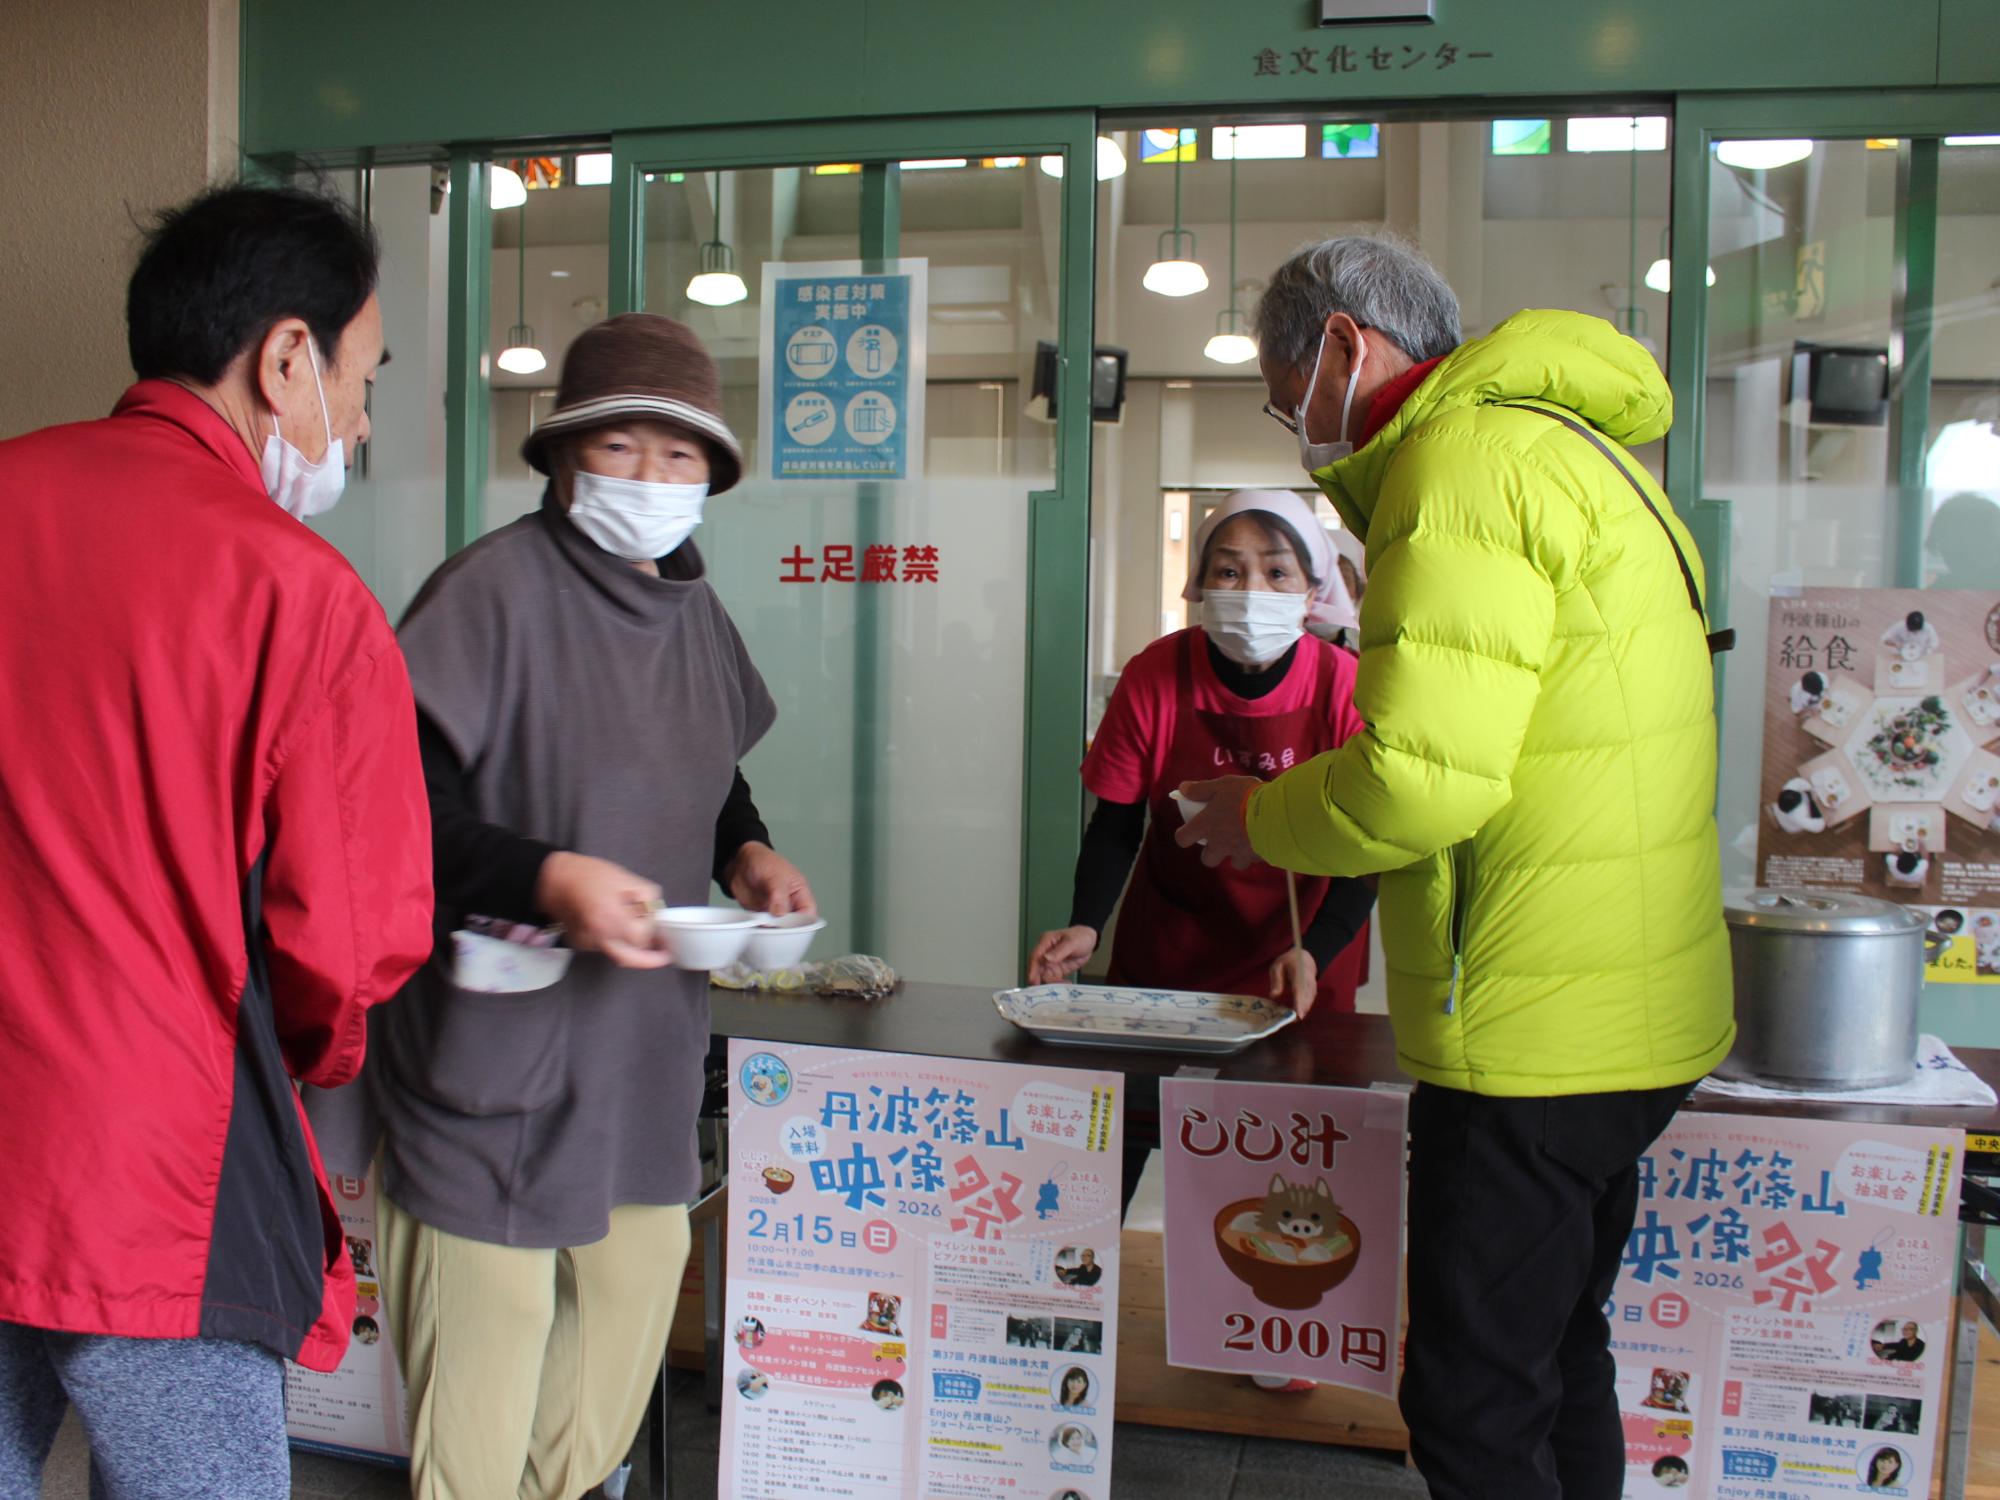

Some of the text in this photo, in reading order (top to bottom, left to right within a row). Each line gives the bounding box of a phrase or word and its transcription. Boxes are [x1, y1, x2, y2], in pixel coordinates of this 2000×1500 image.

[1253, 42, 1494, 77] 食文化センター
[797, 283, 886, 302] 感染症対策
[815, 303, 867, 320] 実施中
[779, 544, 939, 583] 土足厳禁
[1781, 611, 1861, 629] 丹波篠山の
[1780, 634, 1858, 671] 給食
[819, 1084, 1024, 1150] 丹波篠山
[1026, 1103, 1084, 1122] お楽しみ
[789, 1125, 816, 1139] 入場
[1030, 1119, 1077, 1138] 抽選会
[1180, 1106, 1350, 1170] しし汁
[789, 1141, 818, 1155] 無料
[1850, 1164, 1918, 1183] お楽しみ
[1855, 1182, 1908, 1200] 抽選会
[898, 1200, 942, 1217] 2026
[747, 1208, 891, 1249] 2月15日 日
[933, 1251, 989, 1266] ピアノ生演奏
[1694, 1272, 1744, 1289] 2026
[1657, 1299, 1682, 1322] 日
[1730, 1326, 1793, 1340] ピアノ生演奏
[1224, 1313, 1387, 1373] 200円
[933, 1350, 1049, 1370] 第37回 丹波篠山映像大賞
[930, 1408, 959, 1421] Enjoy
[1723, 1426, 1857, 1449] 第37回 丹波篠山映像大賞
[1716, 1485, 1751, 1499] Enjoy
